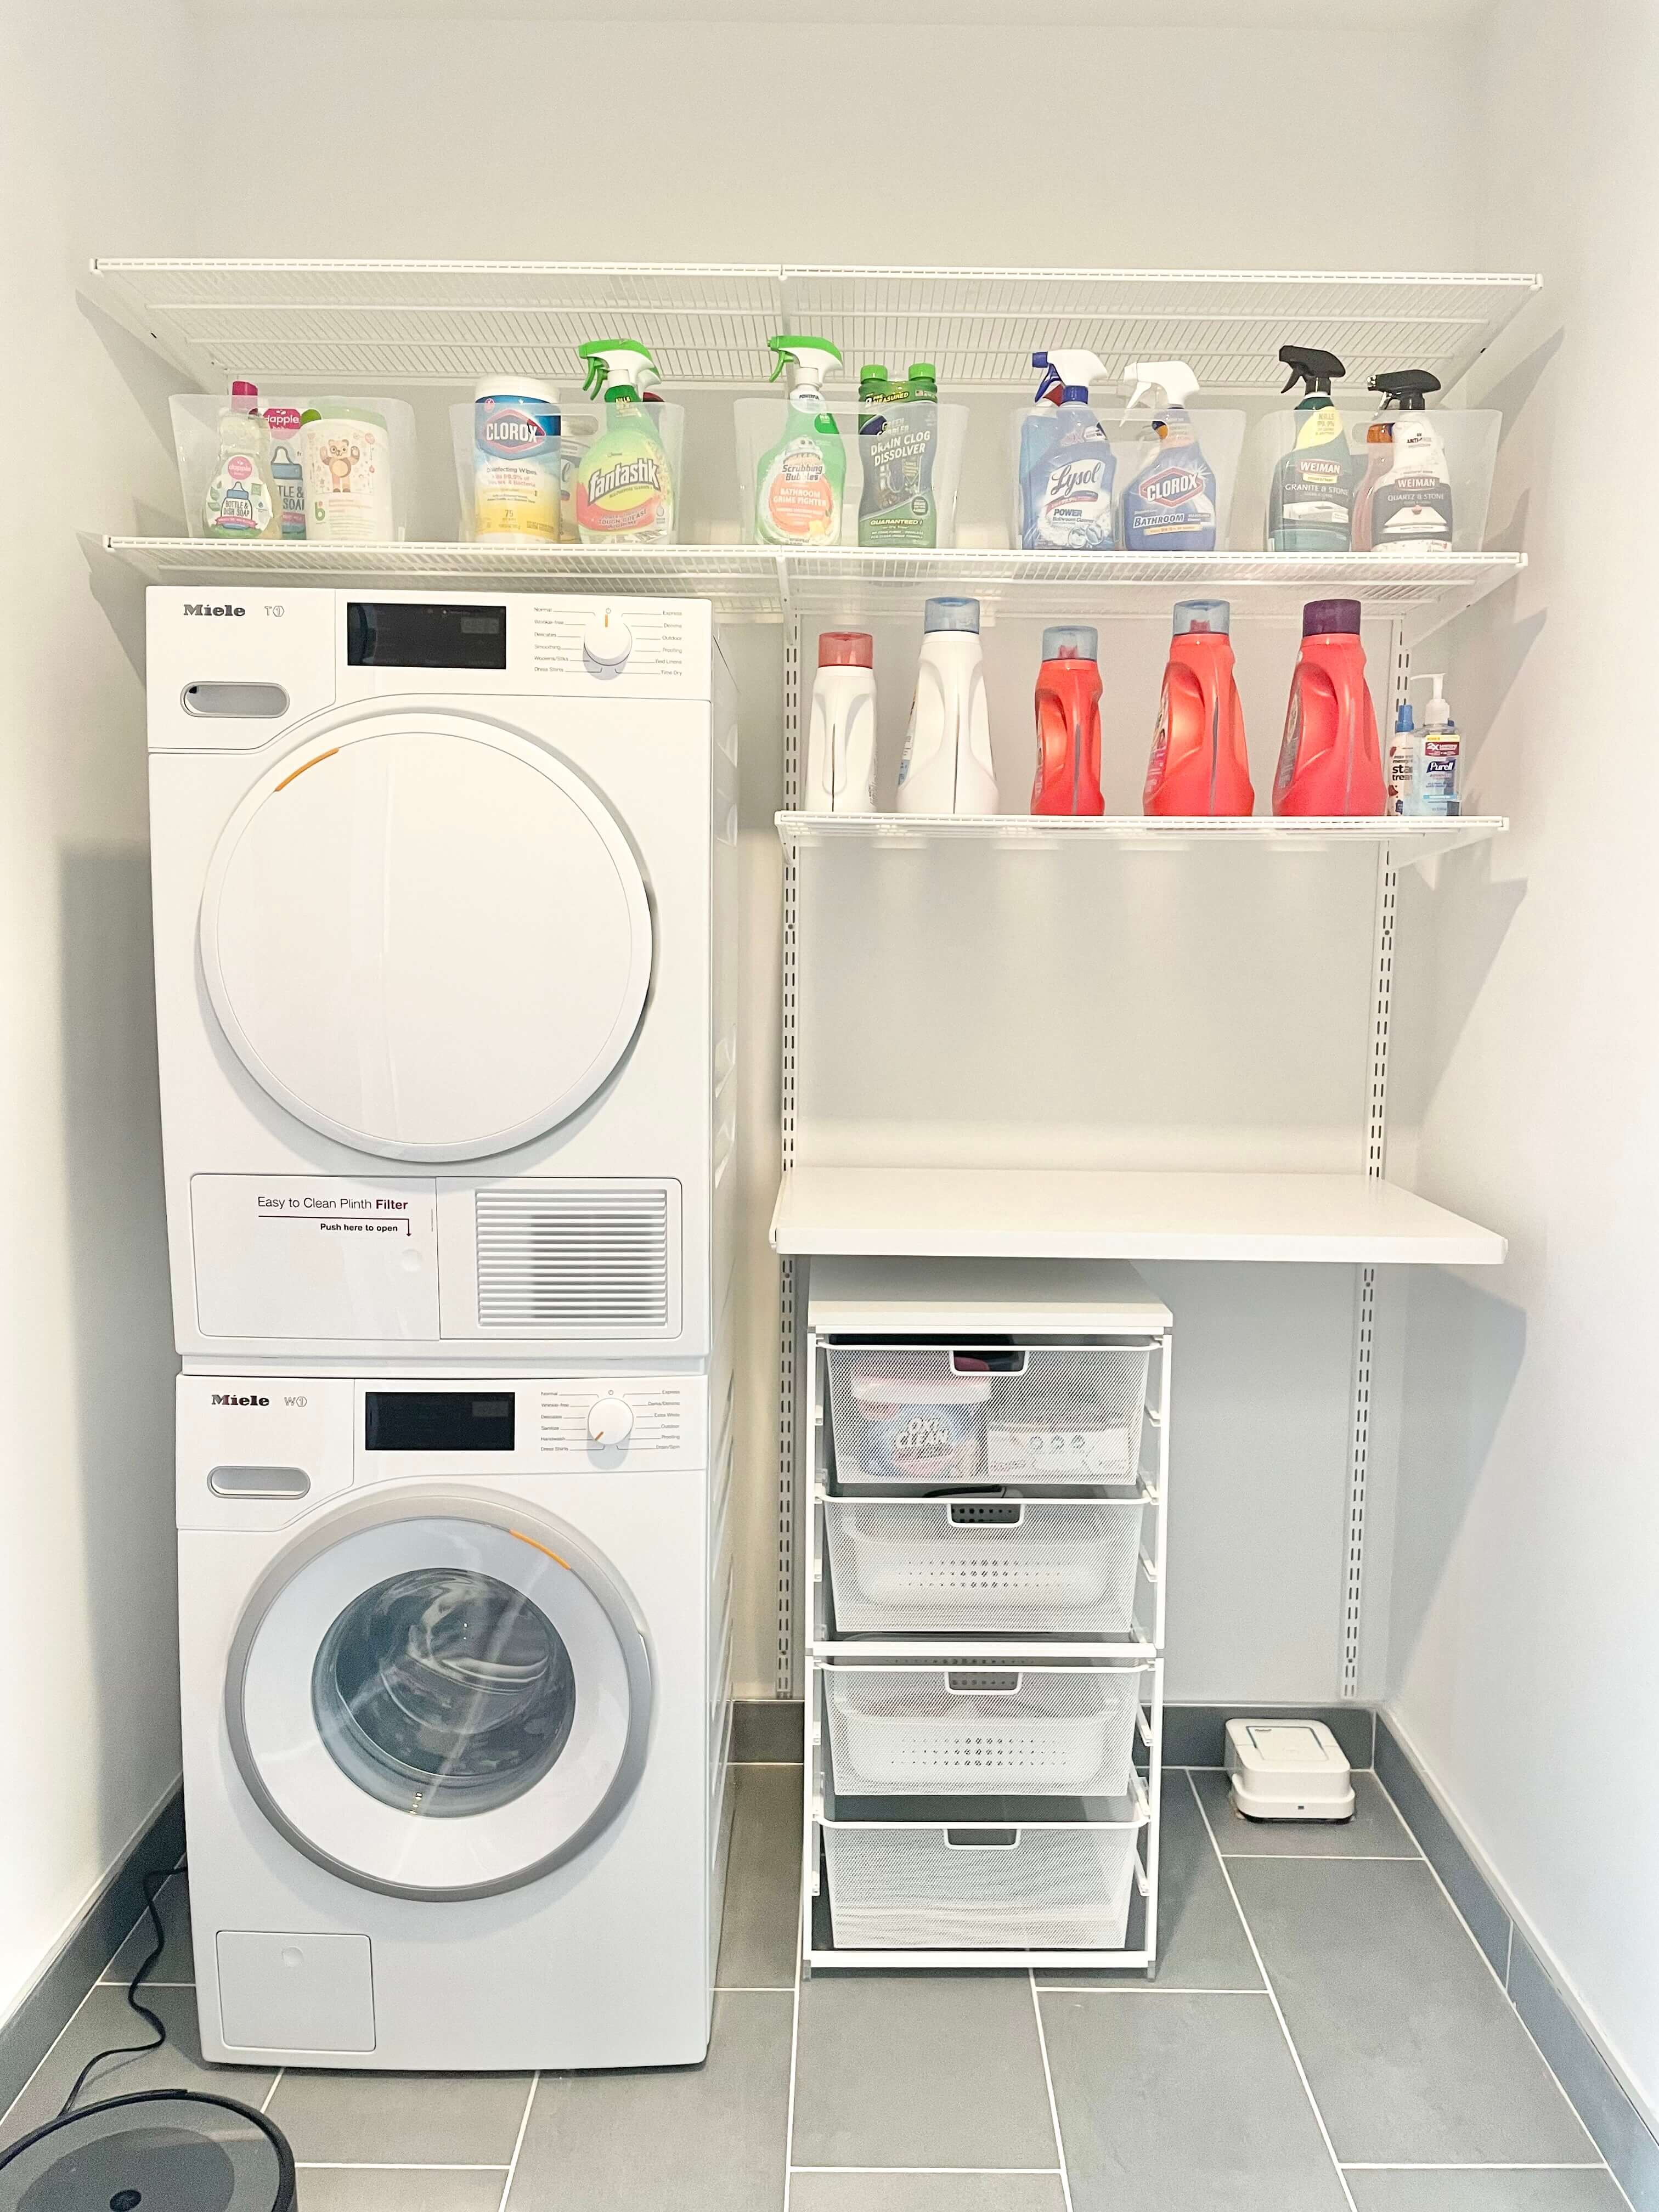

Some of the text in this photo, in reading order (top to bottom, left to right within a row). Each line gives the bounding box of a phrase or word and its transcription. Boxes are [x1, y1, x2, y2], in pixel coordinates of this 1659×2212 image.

[486, 422, 538, 443] CLOROX
[871, 431, 930, 456] DRAIN CLOG
[874, 443, 926, 467] DISSOLVER
[782, 464, 823, 474] Scrubbing
[1300, 461, 1341, 475] WEIMAN
[589, 458, 661, 505] fantastik
[1050, 462, 1102, 496] Lysol
[1397, 478, 1436, 488] WEIMAN
[279, 485, 295, 498] TLE
[780, 488, 821, 498] BATHROOM
[1147, 473, 1198, 501] CLOROX
[1285, 483, 1319, 492] GRANITE
[225, 500, 244, 509] BOTTLE
[798, 496, 827, 506] FIGHTER
[1053, 509, 1082, 517] POWER
[1134, 514, 1184, 527] BATHROOM
[184, 604, 245, 616] Miele
[1430, 762, 1453, 771] Purell
[257, 1196, 408, 1210] Easy to Clean Plinth Filter
[320, 1223, 341, 1231] Push
[376, 1224, 398, 1233] open
[211, 1394, 270, 1407] Miele
